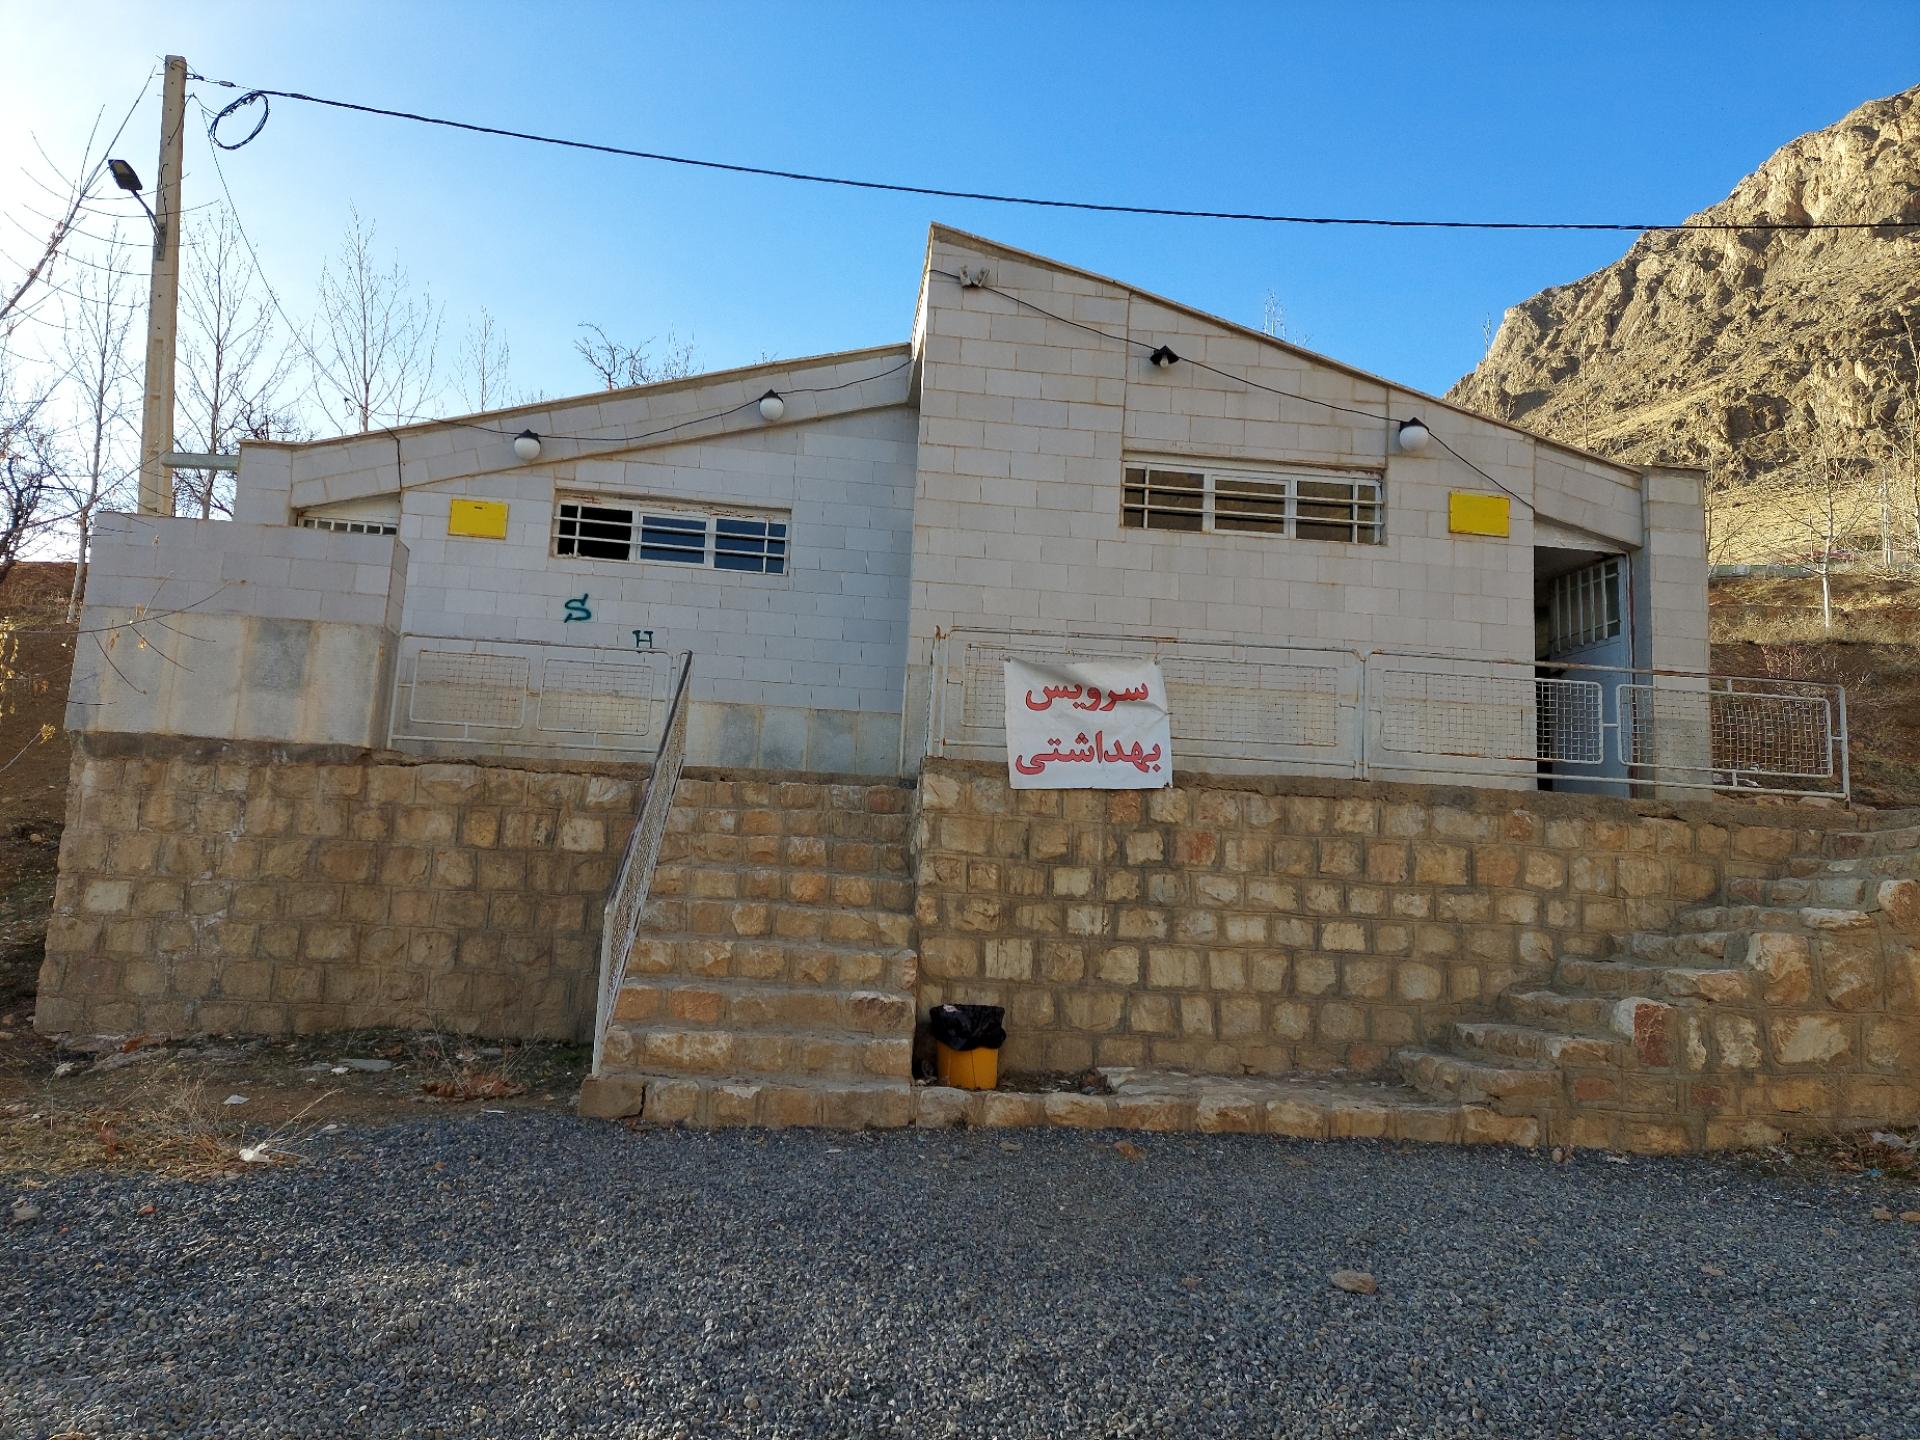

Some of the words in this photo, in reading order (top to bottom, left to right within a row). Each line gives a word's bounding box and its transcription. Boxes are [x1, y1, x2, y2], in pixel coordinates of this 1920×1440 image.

[564, 593, 592, 623] S
[632, 629, 654, 651] H
[1025, 682, 1149, 711] سرویس
[1015, 730, 1162, 775] بهداشتی
